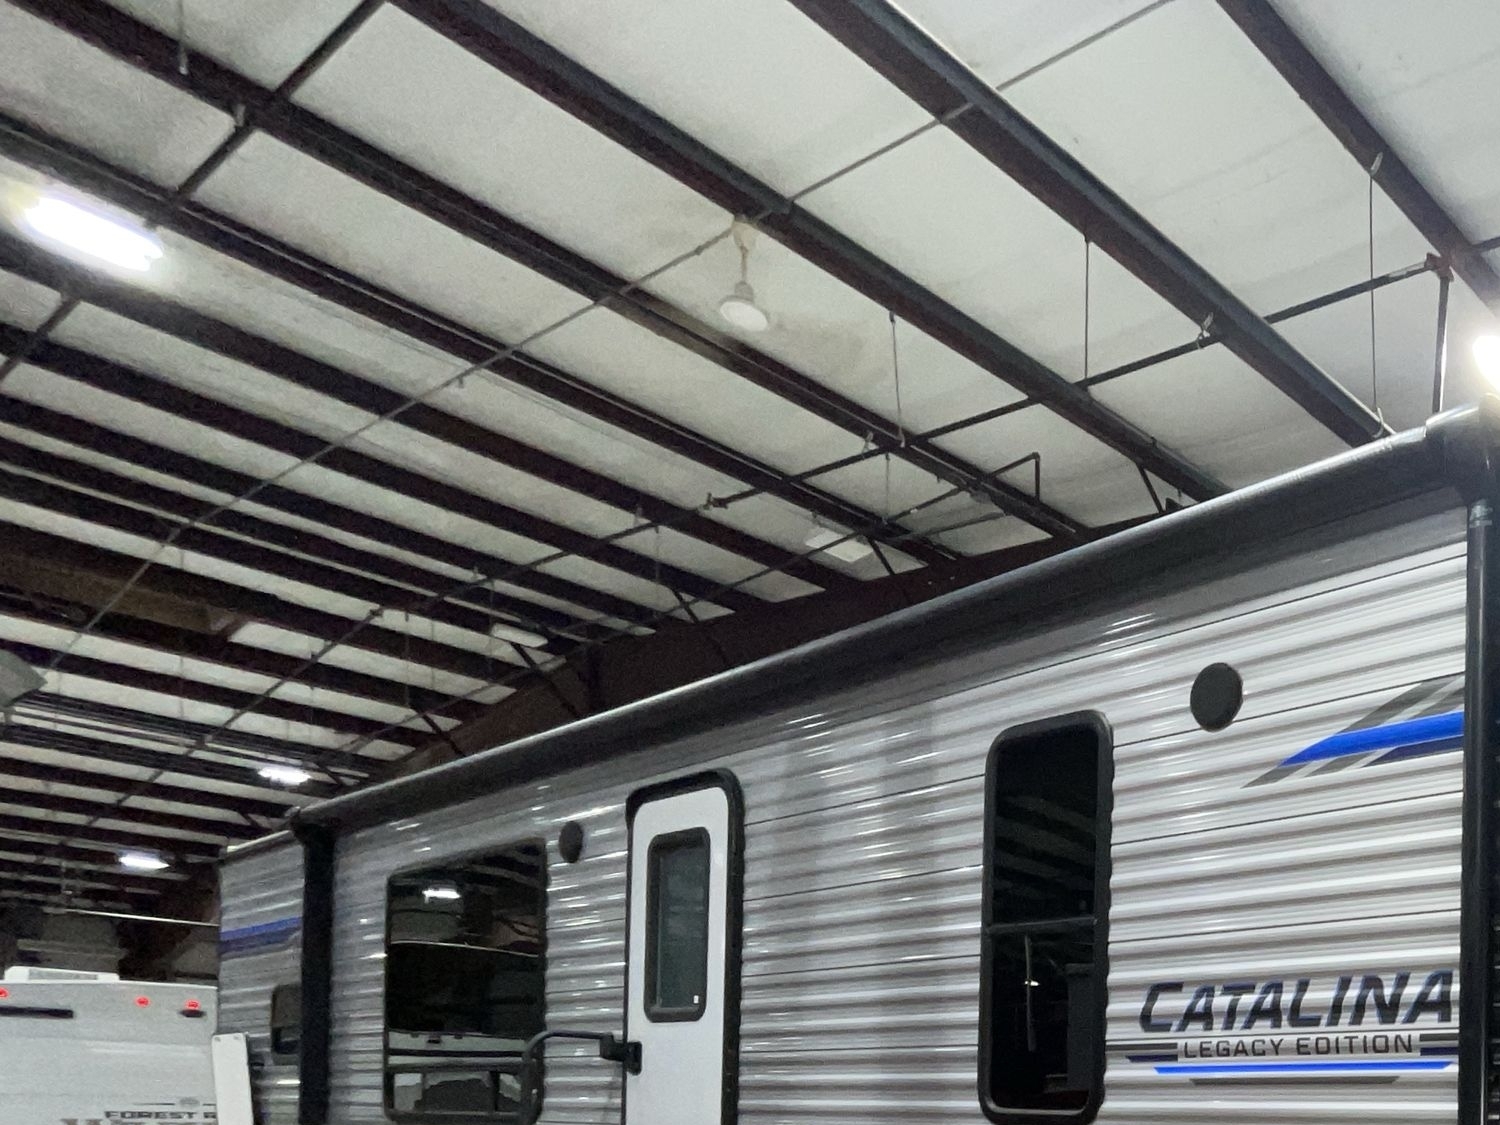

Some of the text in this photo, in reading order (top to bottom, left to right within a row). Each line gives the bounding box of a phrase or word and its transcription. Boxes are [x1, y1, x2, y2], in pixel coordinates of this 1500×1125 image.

[1139, 970, 1454, 1033] CATALINA
[1183, 1033, 1413, 1059] LEGACY EDITION
[104, 1110, 198, 1119] FOREST
